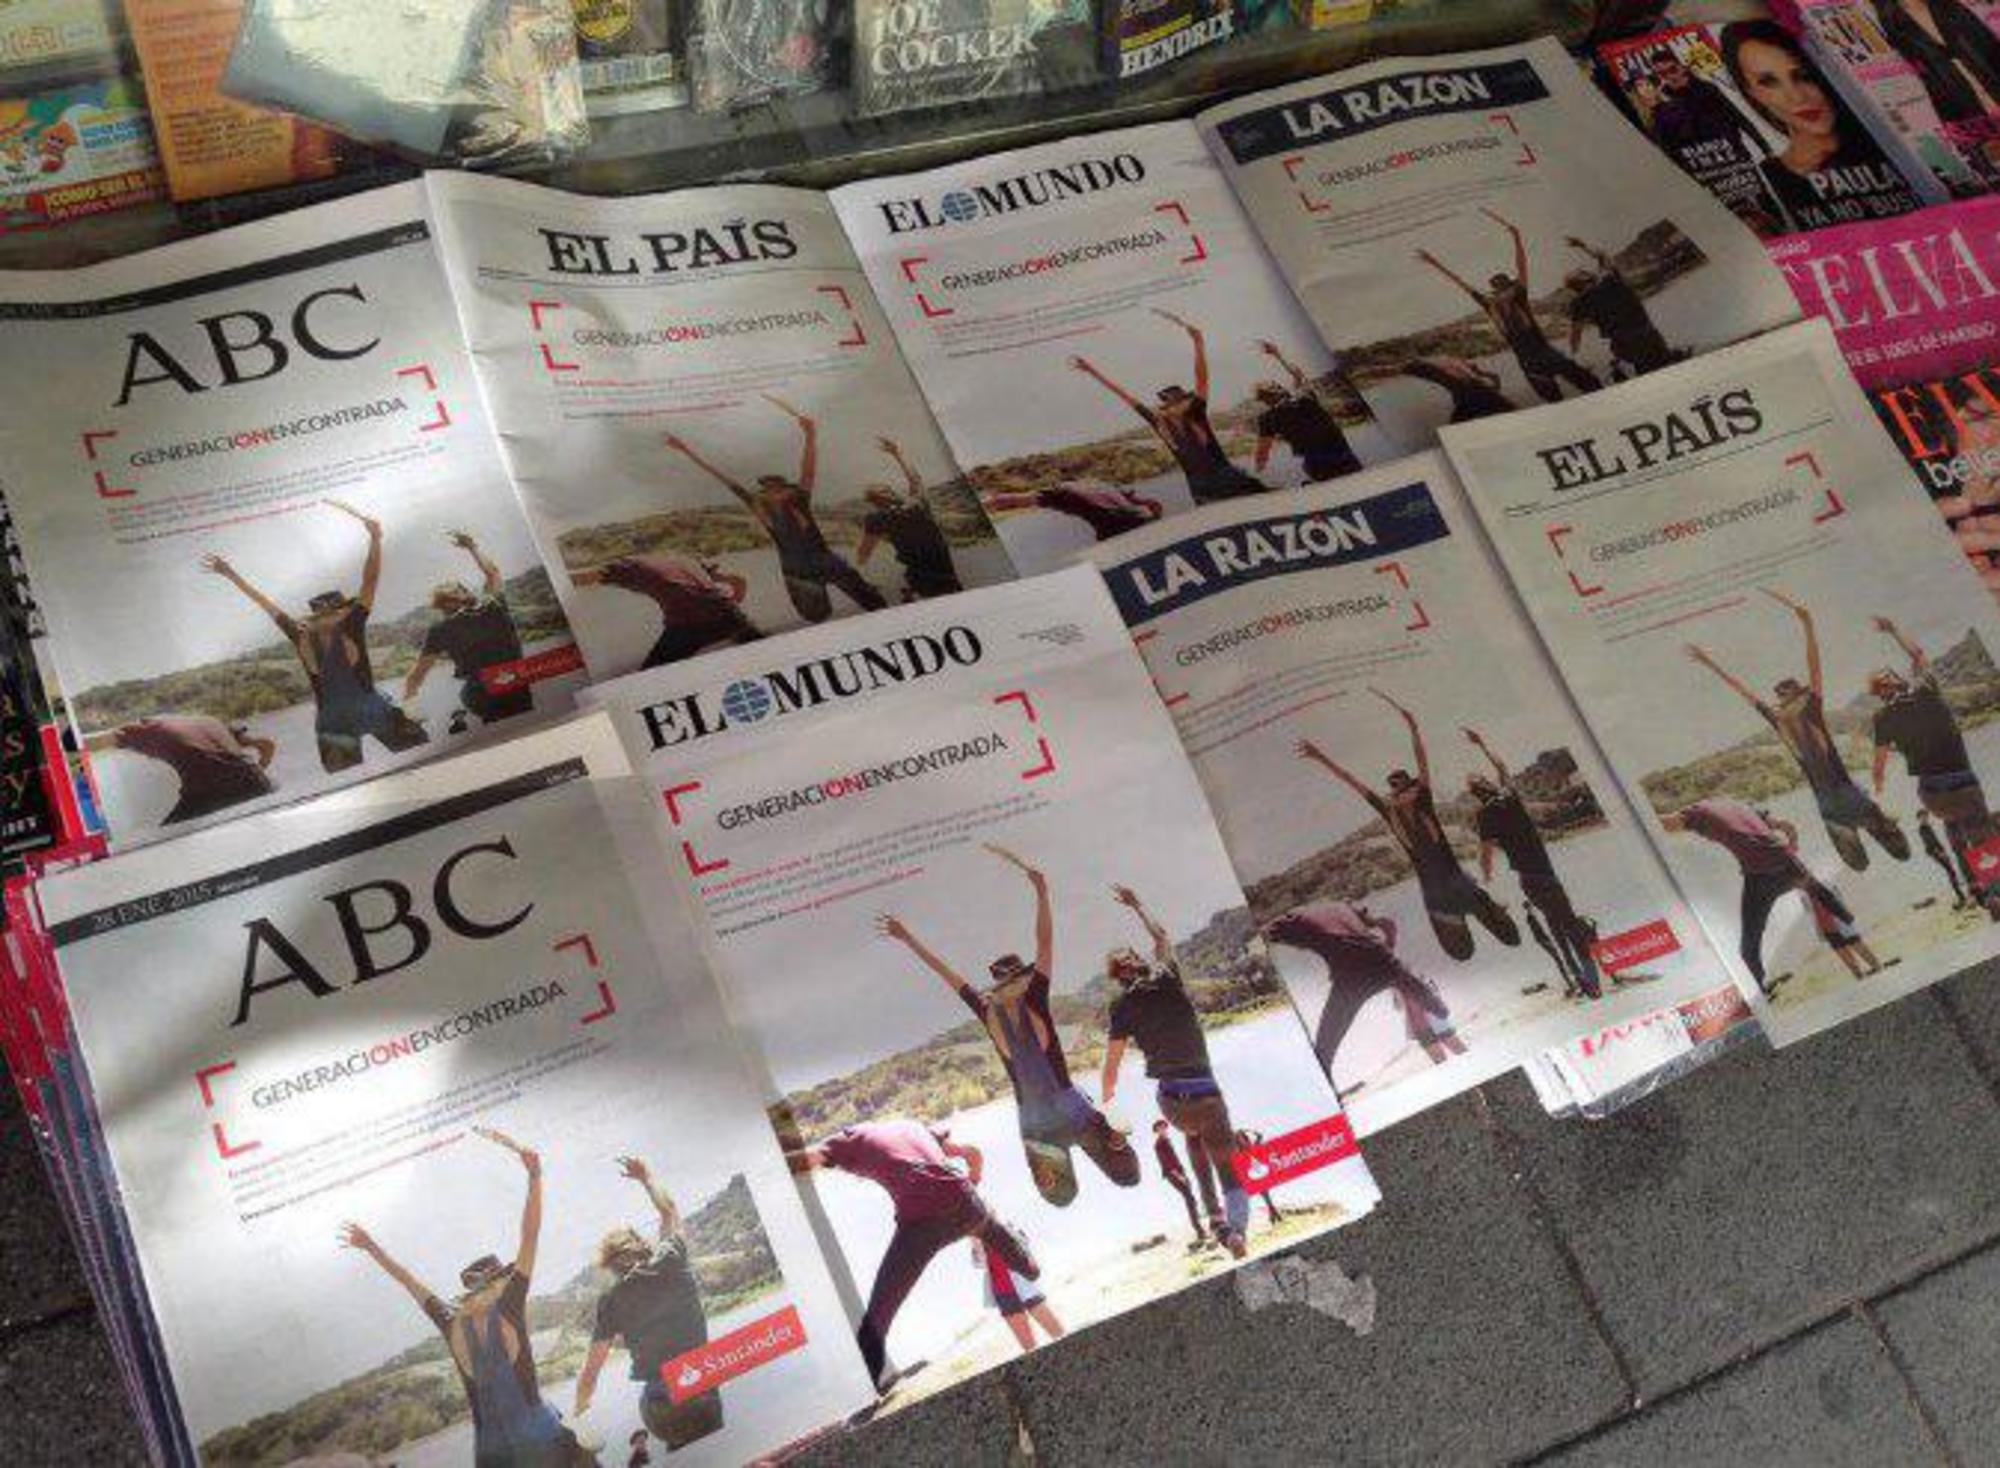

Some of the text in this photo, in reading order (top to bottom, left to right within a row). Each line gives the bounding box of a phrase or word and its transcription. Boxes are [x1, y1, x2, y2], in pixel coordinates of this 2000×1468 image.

[872, 24, 1038, 76] COCKER
[1119, 8, 1236, 79] HENDRIX
[1281, 105, 1344, 139] LA
[879, 153, 1145, 234] EL MUNDO
[538, 227, 640, 277] EL
[1785, 227, 2000, 329] ELVA
[111, 282, 382, 408] ABC
[1536, 438, 1627, 491] EL
[1129, 552, 1206, 604] LA
[636, 624, 984, 753] EL MUNDO
[228, 834, 535, 1029] ABC
